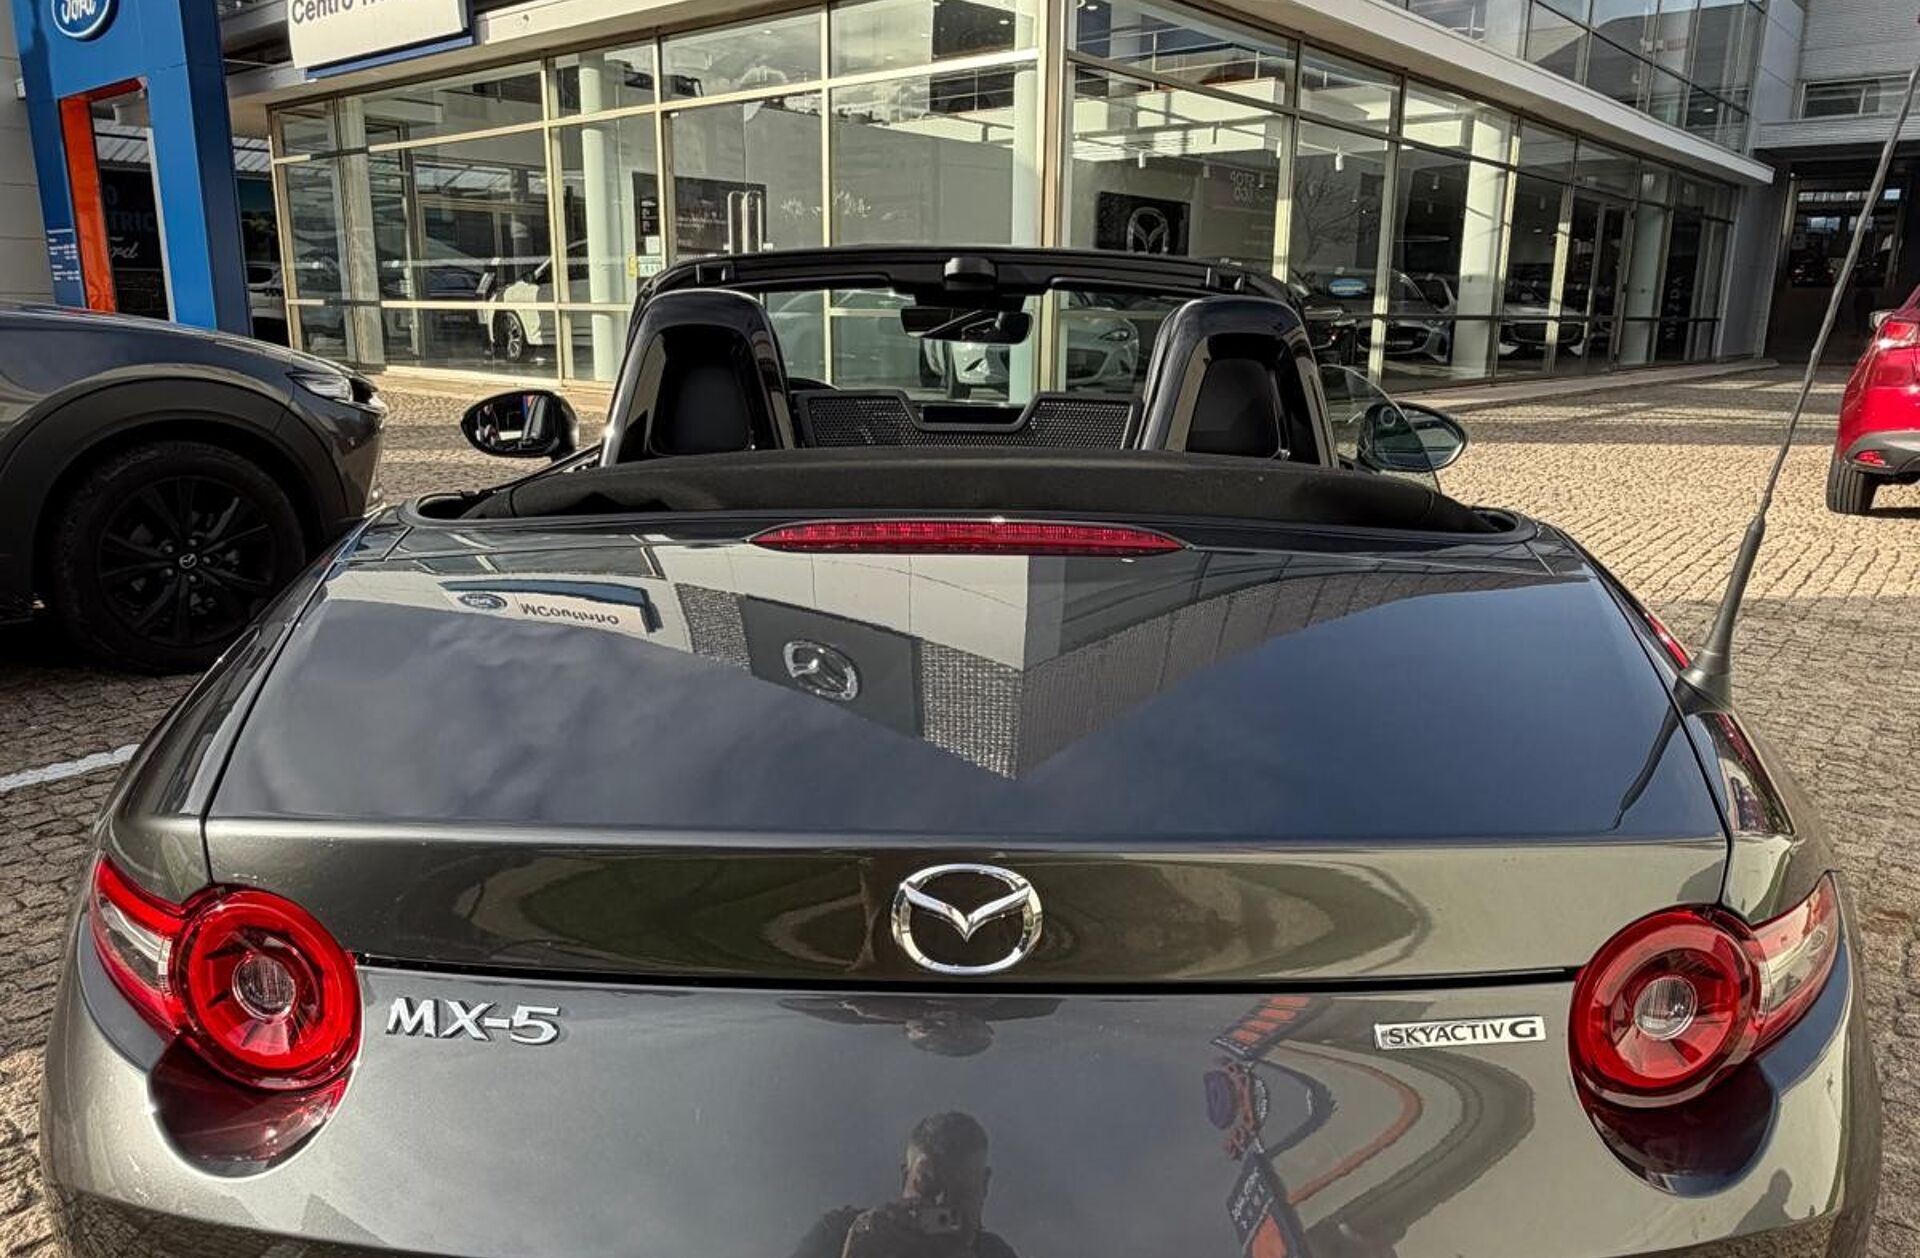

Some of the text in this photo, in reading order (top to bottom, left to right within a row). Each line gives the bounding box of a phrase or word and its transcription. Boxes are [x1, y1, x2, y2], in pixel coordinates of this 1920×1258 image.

[292, 0, 352, 24] Centro
[108, 210, 155, 232] TRIC
[385, 997, 561, 1045] MX-5
